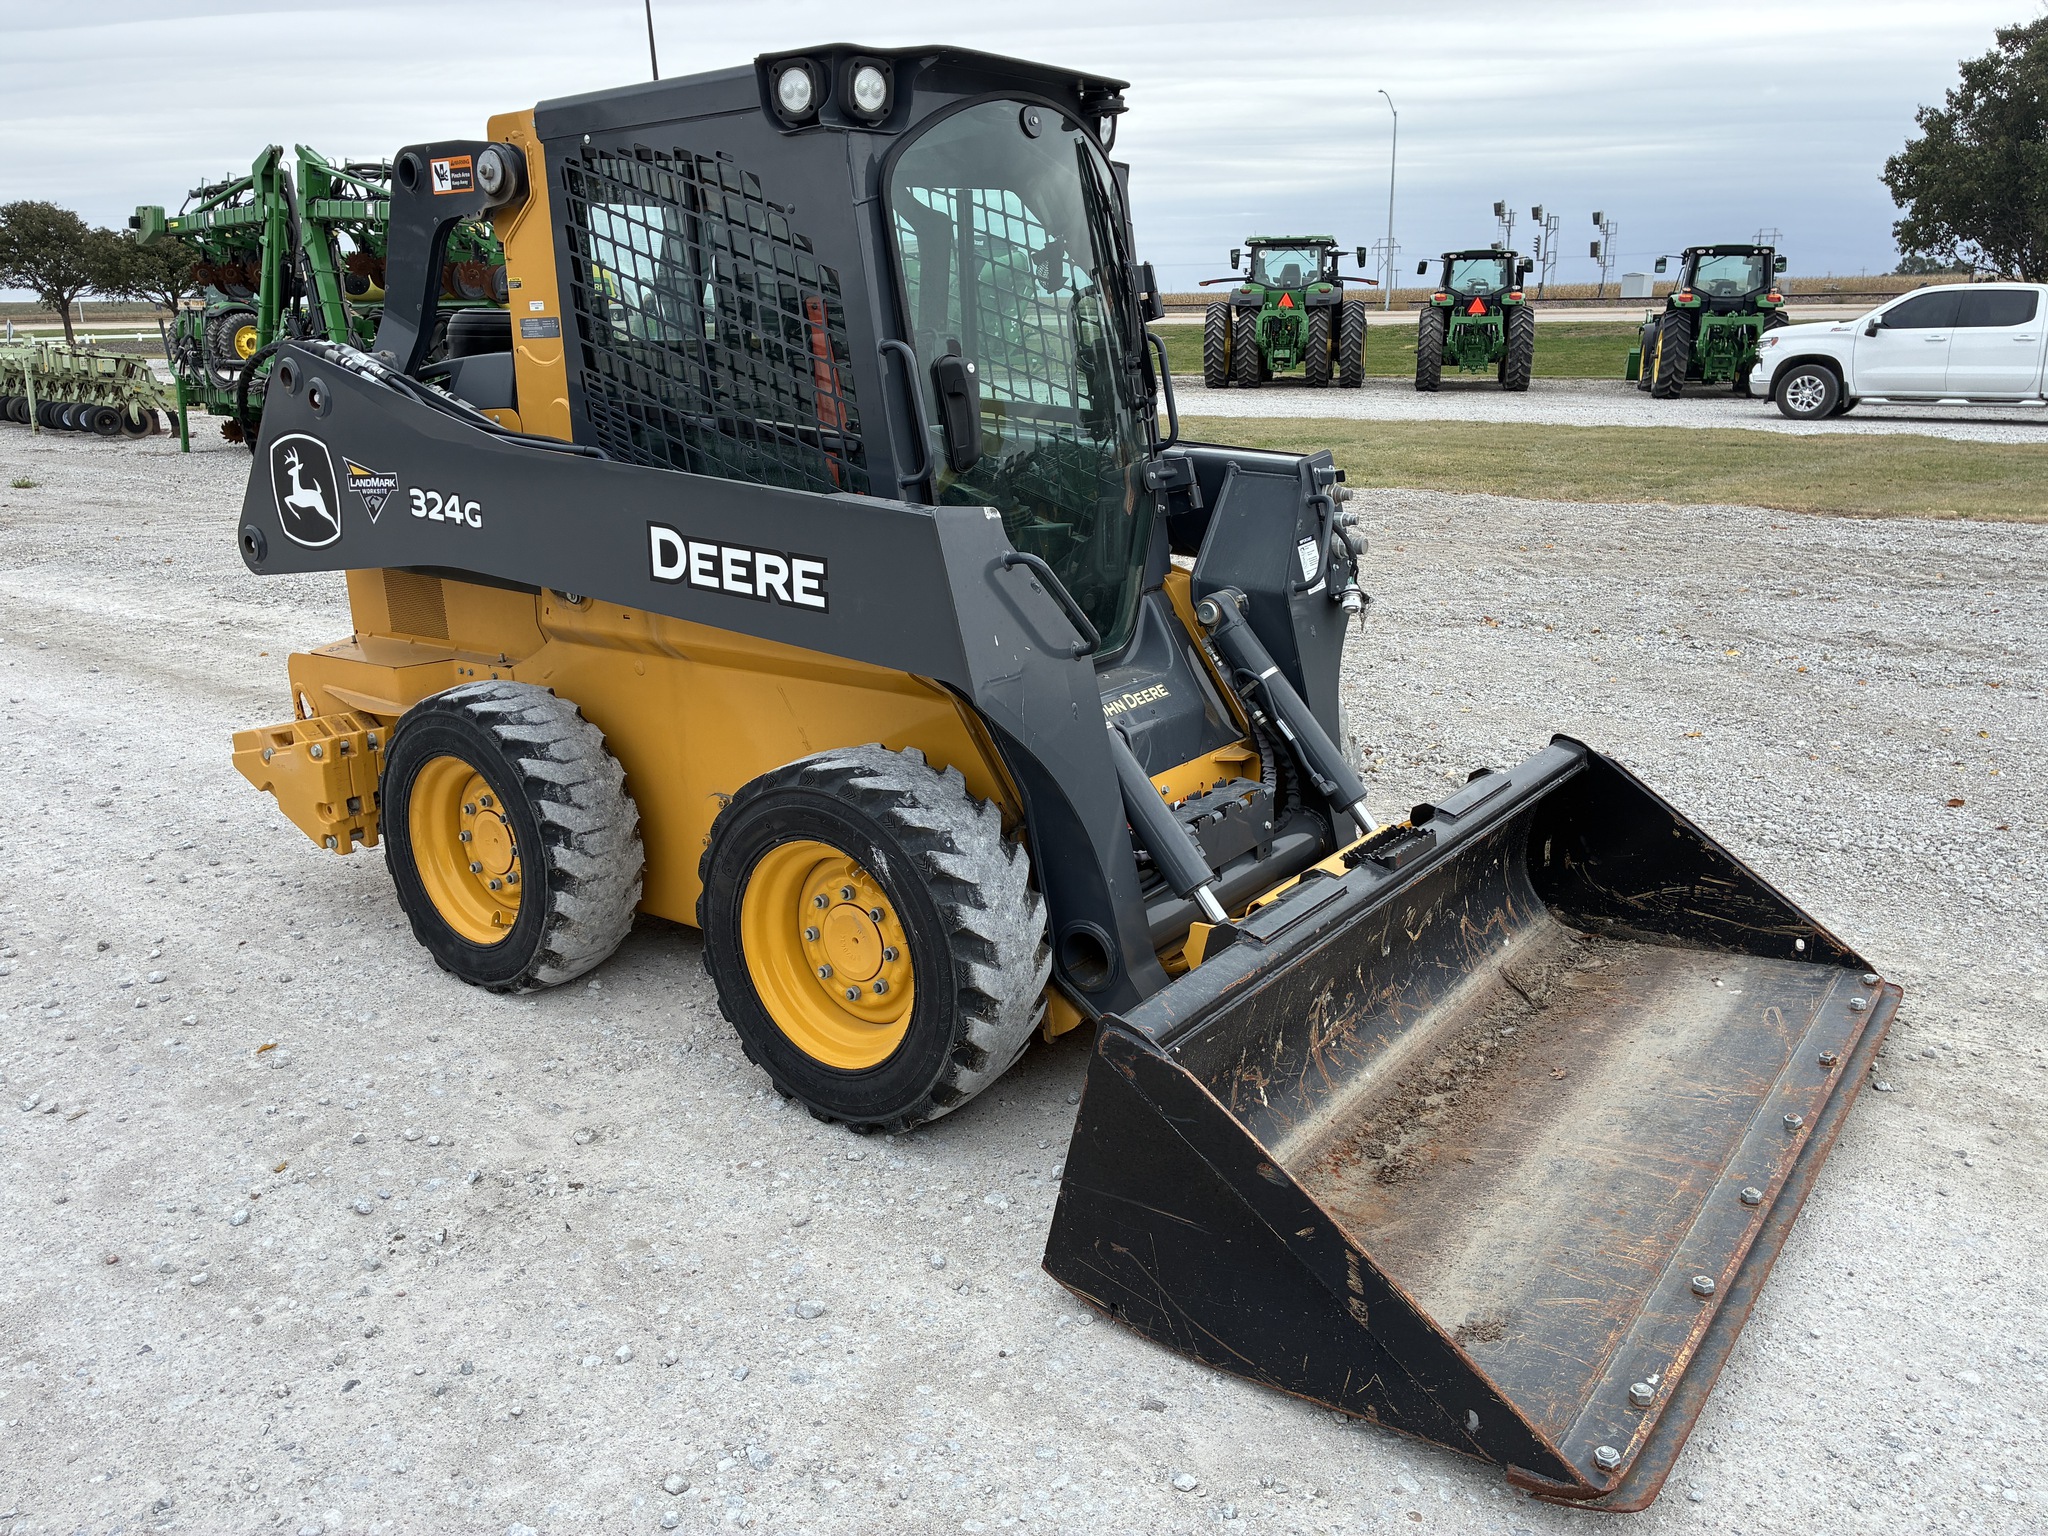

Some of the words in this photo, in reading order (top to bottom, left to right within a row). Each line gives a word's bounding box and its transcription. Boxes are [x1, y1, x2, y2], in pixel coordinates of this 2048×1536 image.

[350, 477, 396, 488] LANDMARK
[409, 488, 482, 528] 324G
[650, 525, 826, 608] DEERE
[1122, 683, 1170, 709] DEERE
